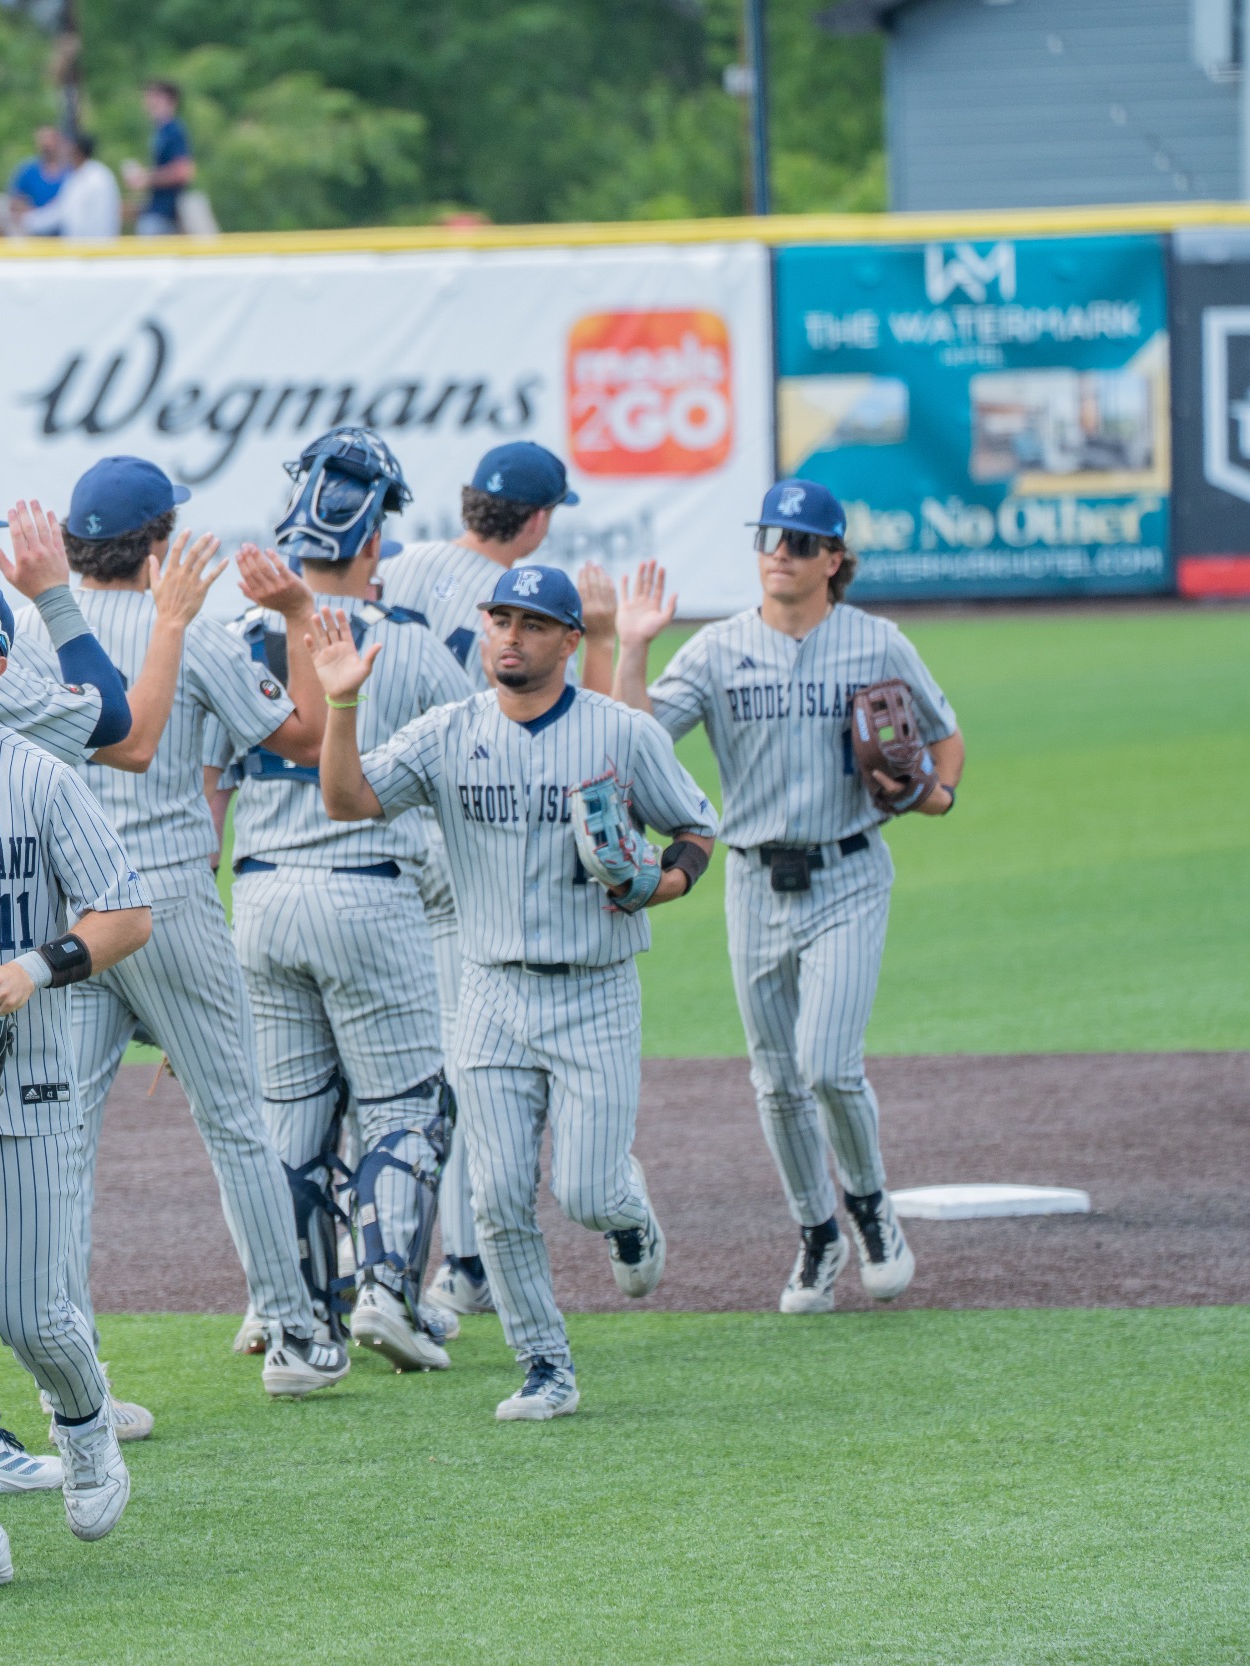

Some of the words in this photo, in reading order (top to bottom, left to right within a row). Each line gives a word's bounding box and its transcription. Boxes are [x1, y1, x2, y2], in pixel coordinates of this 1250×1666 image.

[804, 308, 879, 350] THE
[887, 299, 1141, 345] WATERMARK
[574, 330, 725, 387] meals
[20, 313, 543, 485] Wegmans
[573, 383, 728, 452] 2GO
[920, 496, 996, 550] No
[726, 682, 791, 722] RHODE
[798, 682, 868, 718] ISLA
[458, 784, 530, 823] RHODE
[538, 784, 572, 823] ISL
